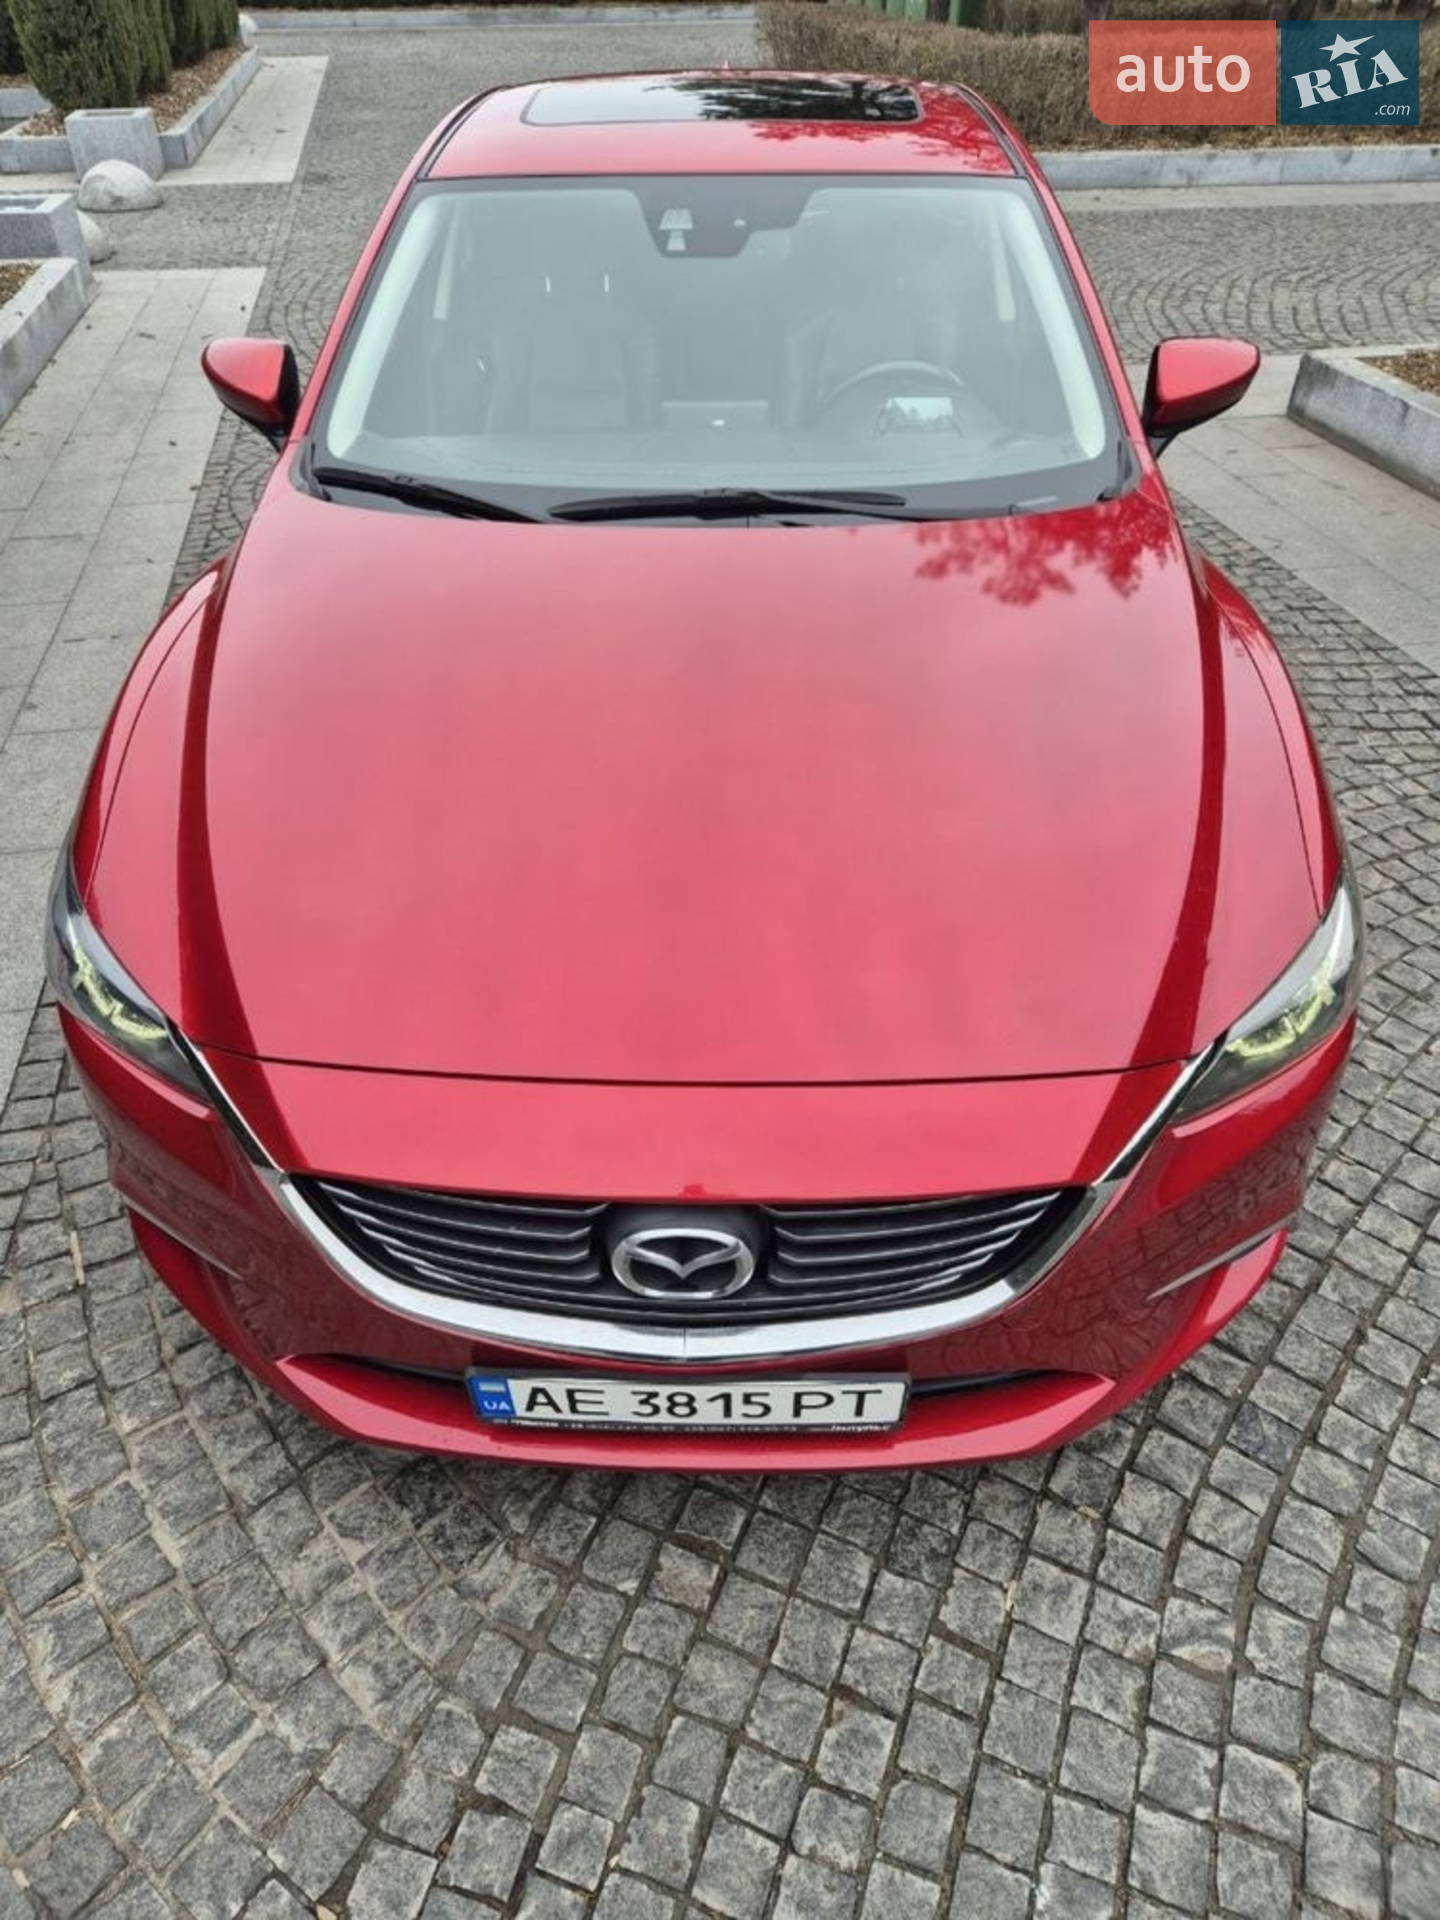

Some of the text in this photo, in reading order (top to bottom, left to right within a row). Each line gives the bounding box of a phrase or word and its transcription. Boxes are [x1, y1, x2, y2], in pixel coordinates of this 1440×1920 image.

[483, 1399, 512, 1412] UA
[525, 1386, 882, 1419] AE 3815 PT
